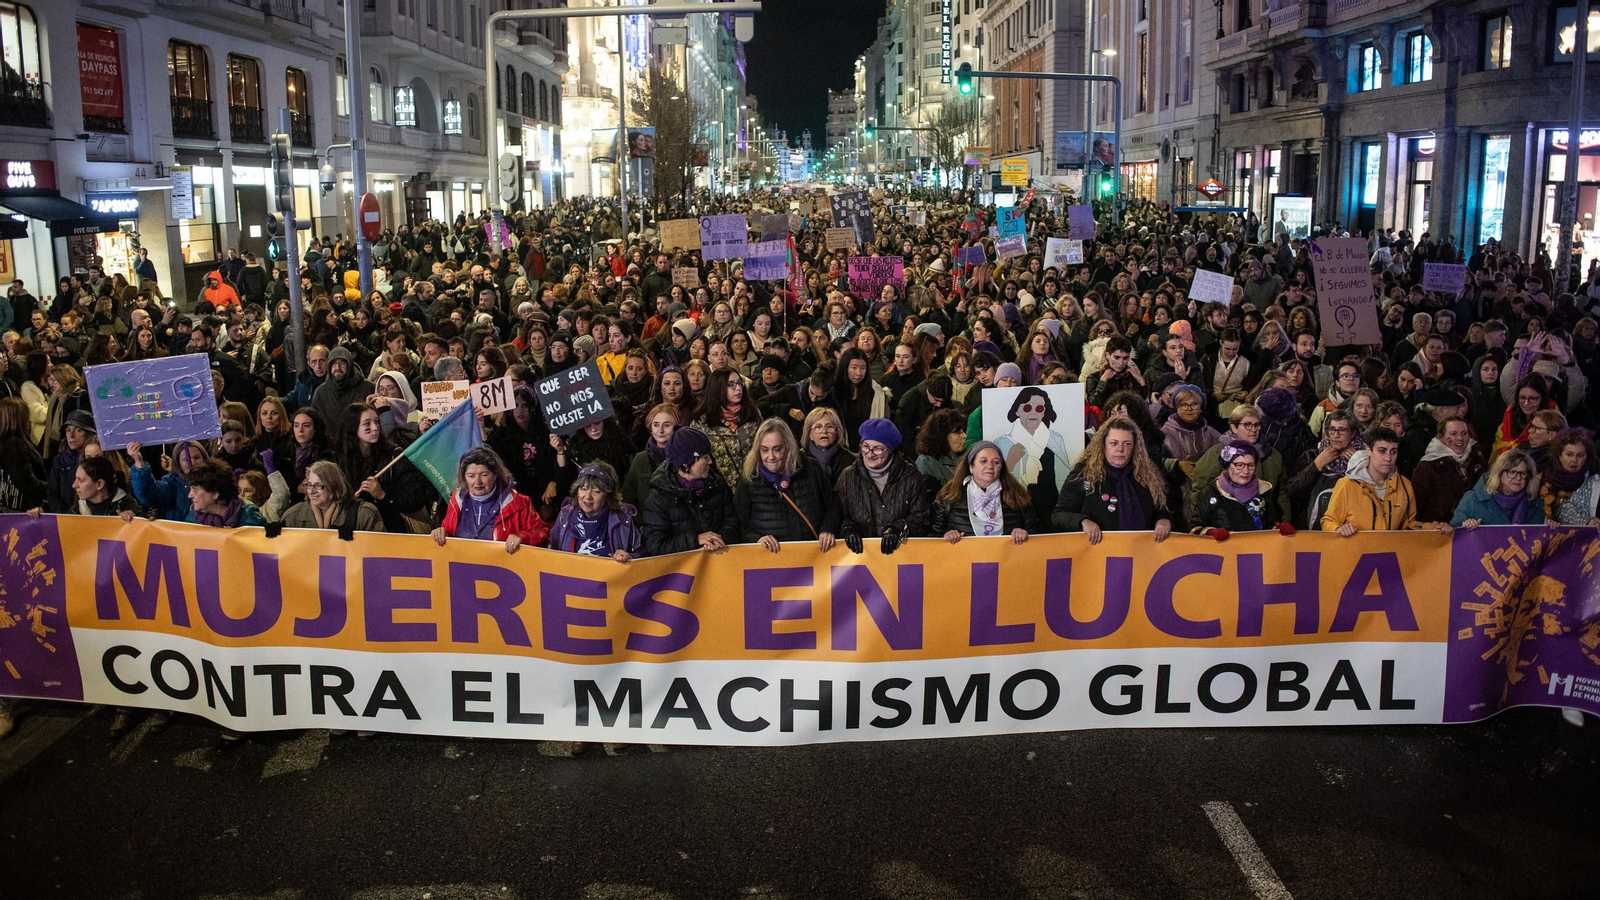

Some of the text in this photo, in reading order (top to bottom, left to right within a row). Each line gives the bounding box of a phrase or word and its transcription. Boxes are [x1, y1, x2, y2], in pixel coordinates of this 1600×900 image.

[94, 53, 116, 63] REUNIÓN
[82, 60, 117, 75] DAYPASS
[8, 162, 32, 175] FIVE
[135, 168, 146, 178] 44
[7, 175, 36, 188] GUYS
[702, 218, 724, 235] QUE
[1327, 249, 1332, 260] 8
[1336, 247, 1343, 259] de
[1346, 248, 1366, 259] Marzo
[1340, 266, 1368, 274] CELEBRA
[1328, 295, 1373, 307] LUCHANDO!
[540, 366, 590, 394] QUE SER
[423, 382, 454, 393] MARCHO
[480, 379, 507, 409] 8M
[453, 390, 468, 400] HOY
[545, 387, 594, 415] NO NOS
[550, 408, 585, 429] CUESTE
[588, 400, 603, 414] LA
[422, 460, 440, 477] PARTIDO
[95, 538, 700, 656] MUJERES
[744, 564, 924, 651] EN
[969, 552, 1420, 646] LUCHA
[101, 644, 1415, 732] CONTRA EL MACHISMO GLOBAL
